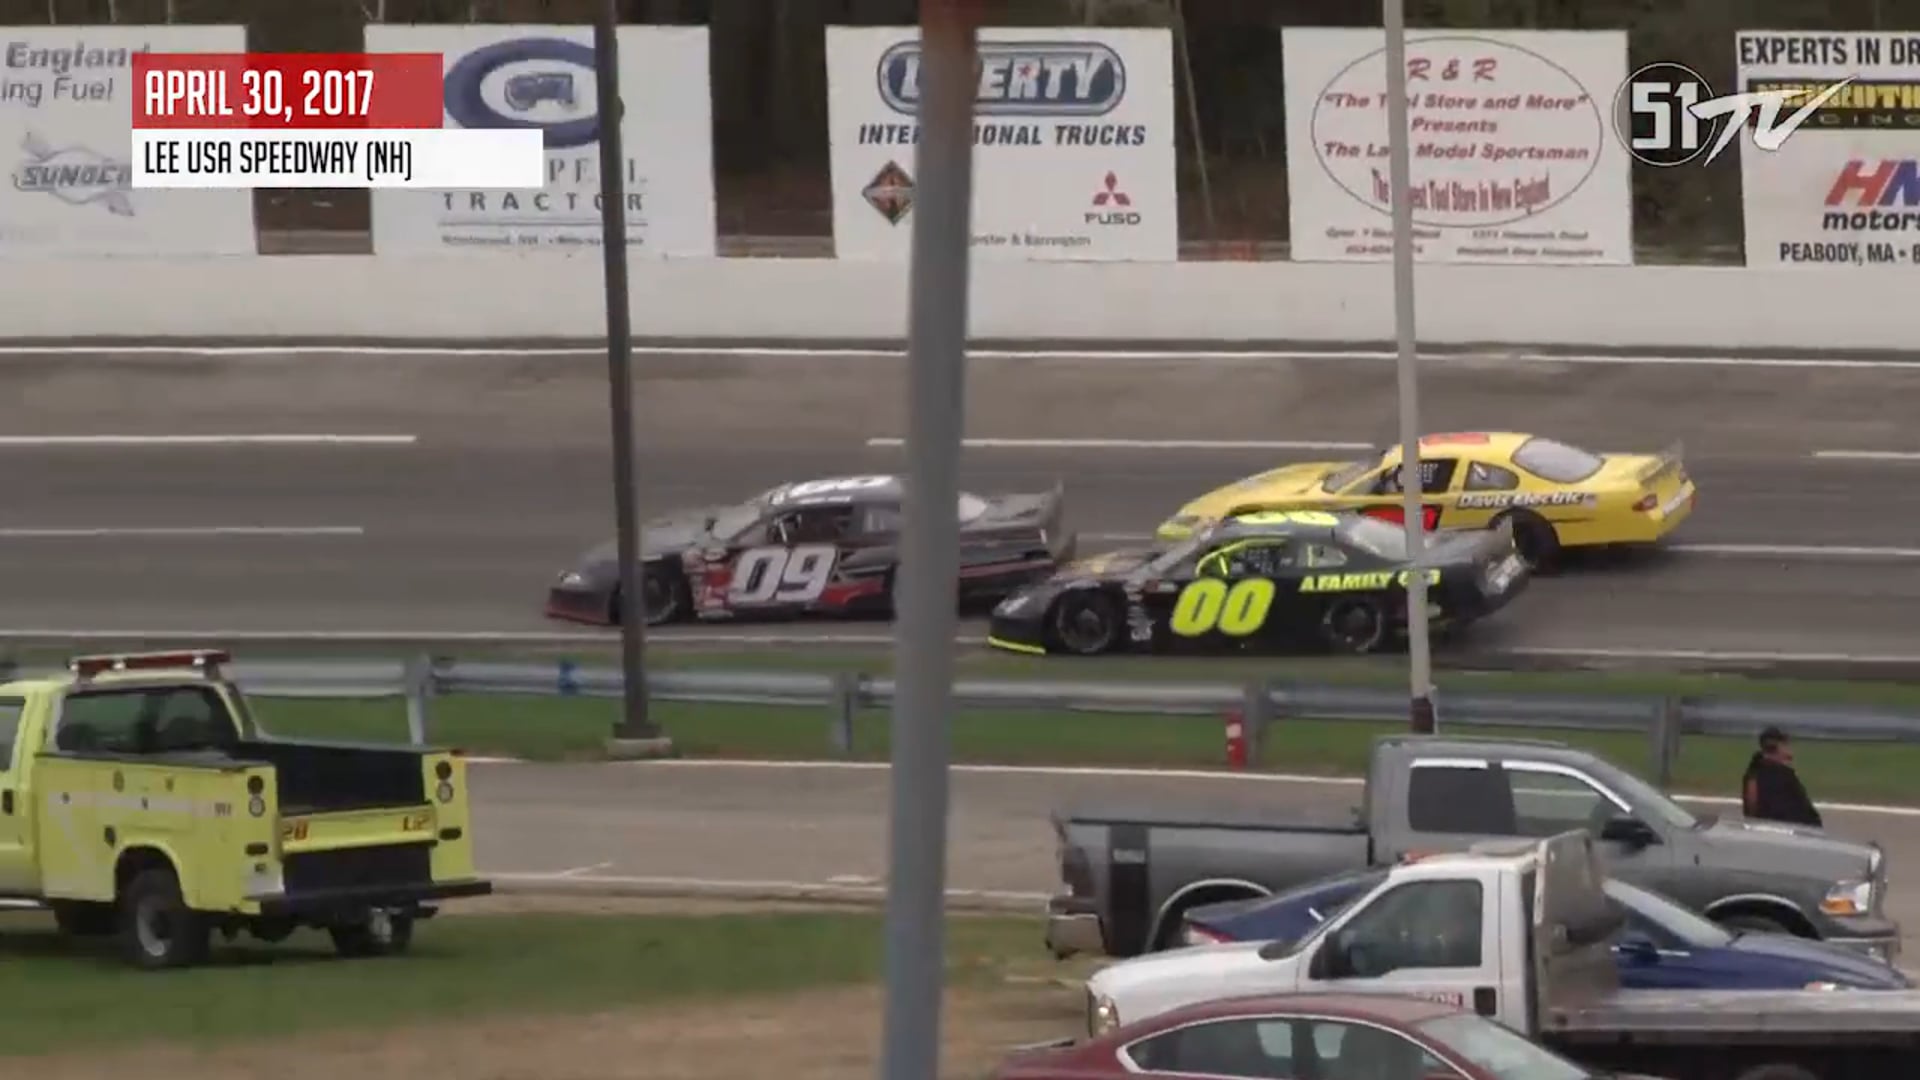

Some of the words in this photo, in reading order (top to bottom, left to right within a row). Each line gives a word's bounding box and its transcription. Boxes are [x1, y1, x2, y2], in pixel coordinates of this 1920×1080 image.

[6, 41, 150, 74] Englan
[1740, 37, 1848, 66] EXPERTS
[1856, 38, 1881, 65] IN
[901, 55, 1101, 99] LERTY
[1407, 58, 1431, 81] R
[1473, 58, 1497, 81] R
[54, 76, 113, 101] Fuel
[1425, 94, 1476, 110] Store
[1483, 94, 1518, 110] and
[1055, 125, 1146, 147] TRUCKS
[1411, 117, 1498, 132] Presents
[1324, 141, 1361, 157] The
[1416, 143, 1476, 158] Model
[1481, 143, 1590, 162] Sportsman
[1780, 242, 1862, 265] PEABODY,
[1868, 244, 1896, 263] MA
[729, 547, 837, 601] 09
[1318, 571, 1392, 591] FAMILY
[1170, 577, 1276, 637] 00
